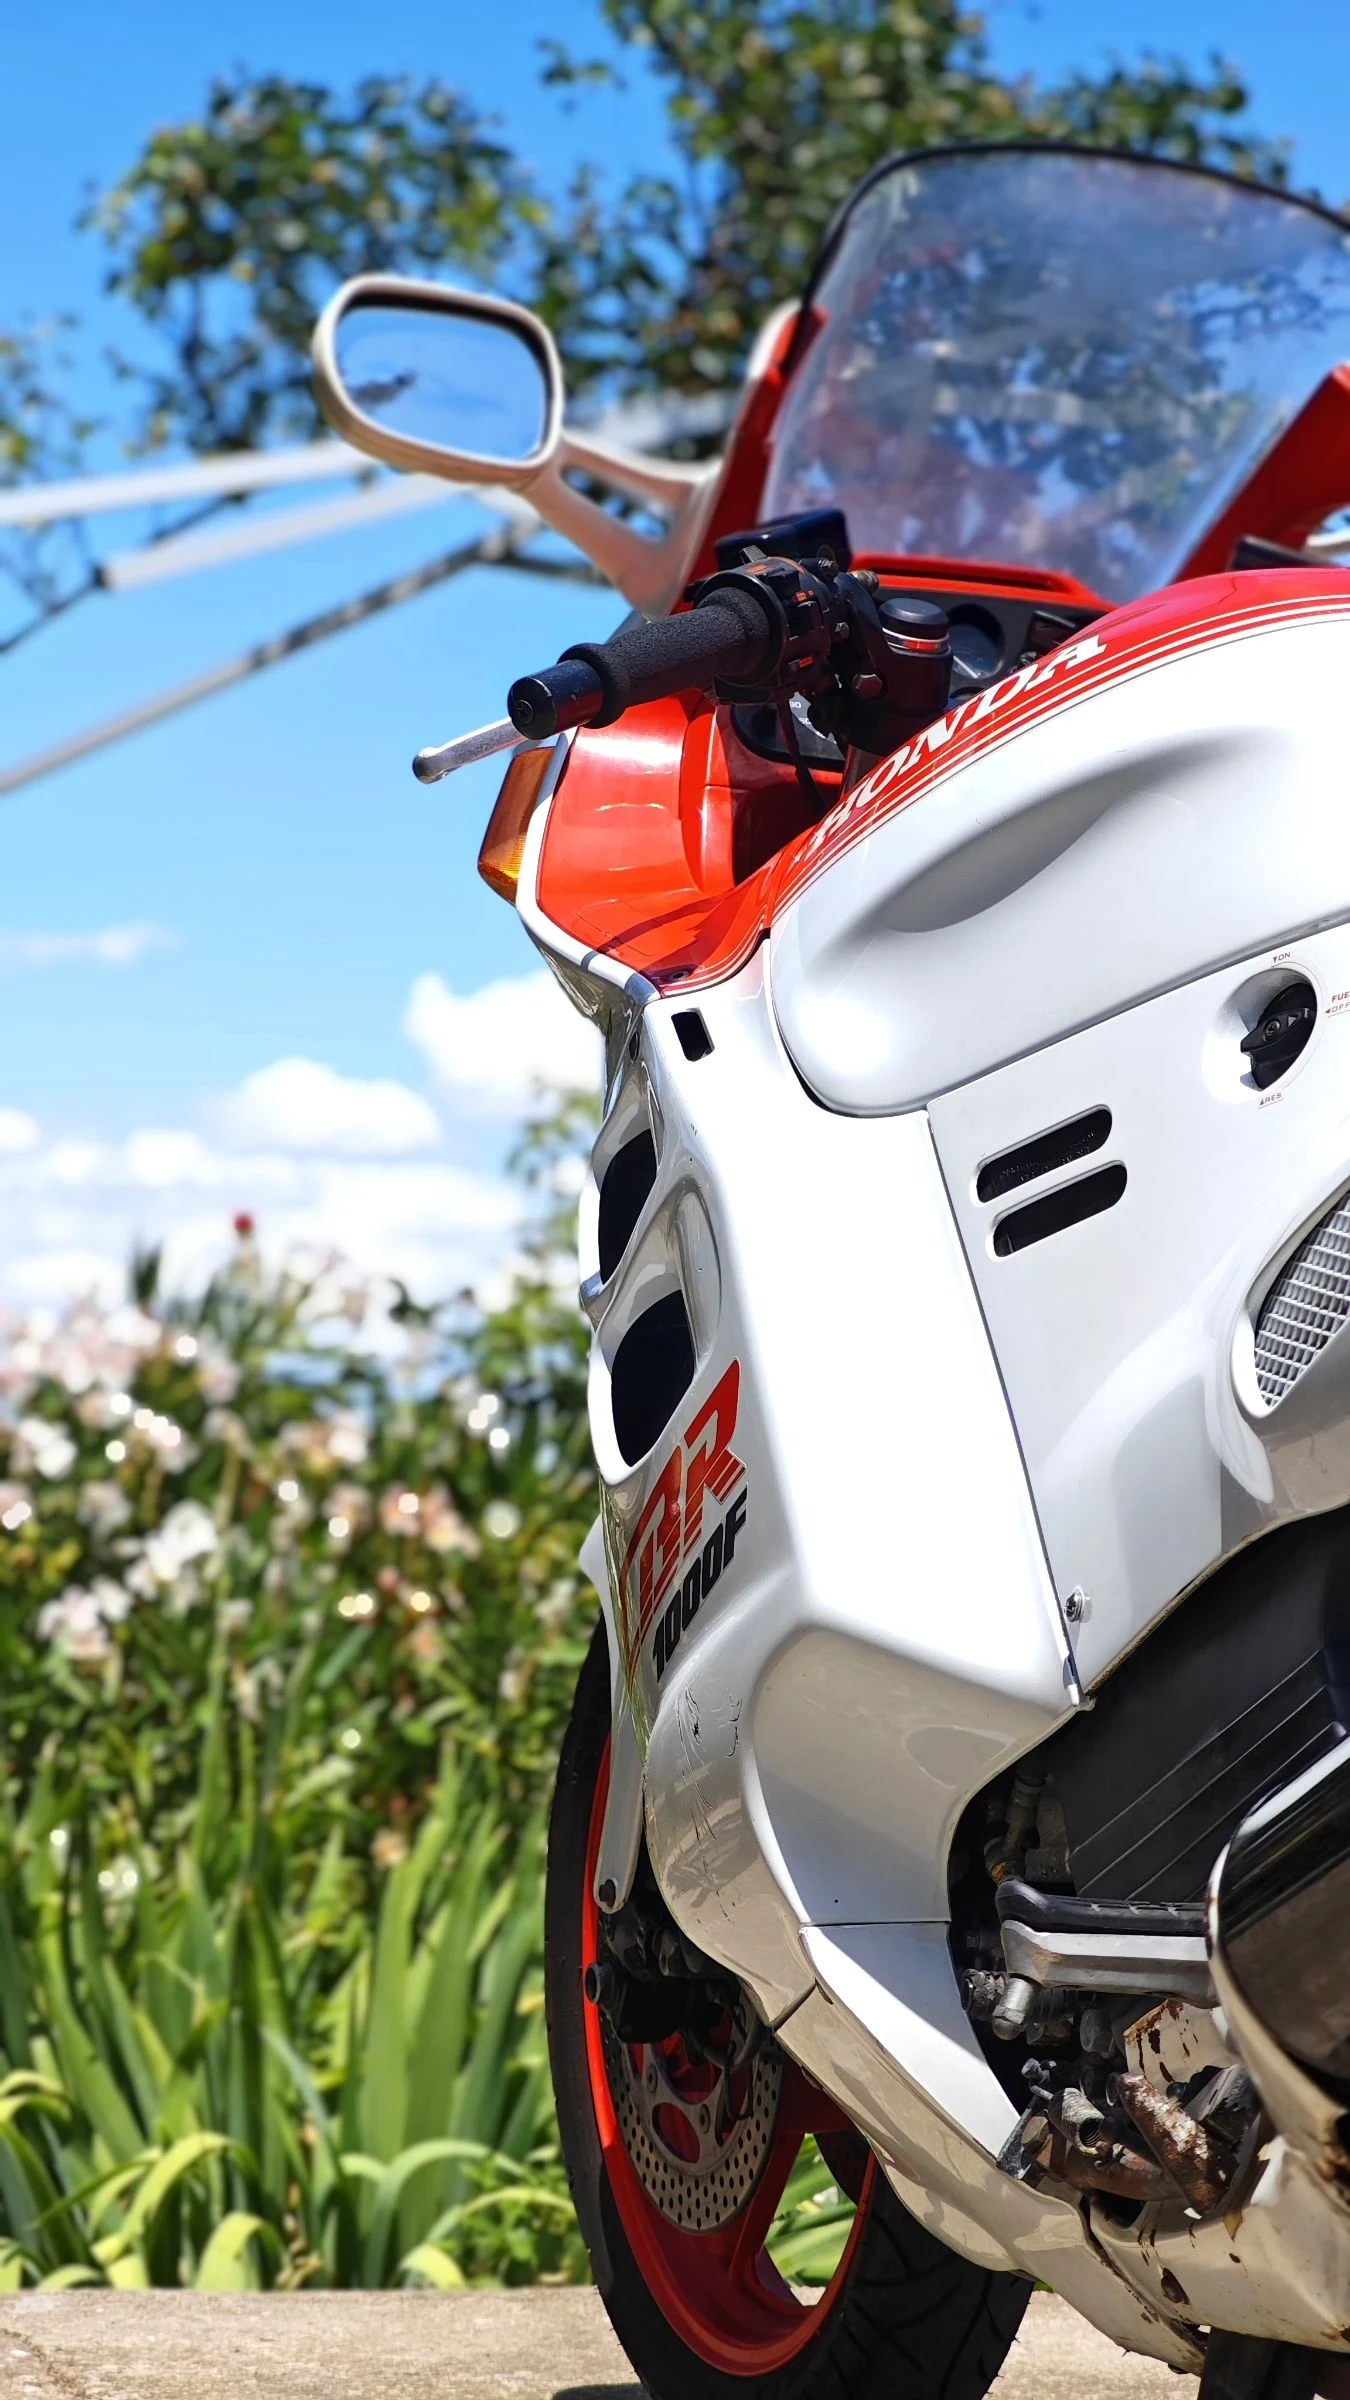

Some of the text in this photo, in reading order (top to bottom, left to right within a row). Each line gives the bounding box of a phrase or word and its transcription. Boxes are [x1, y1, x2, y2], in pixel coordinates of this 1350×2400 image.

[794, 634, 1108, 863] HONDA
[1264, 1092, 1282, 1103] RES
[652, 1484, 748, 1684] 1000F
